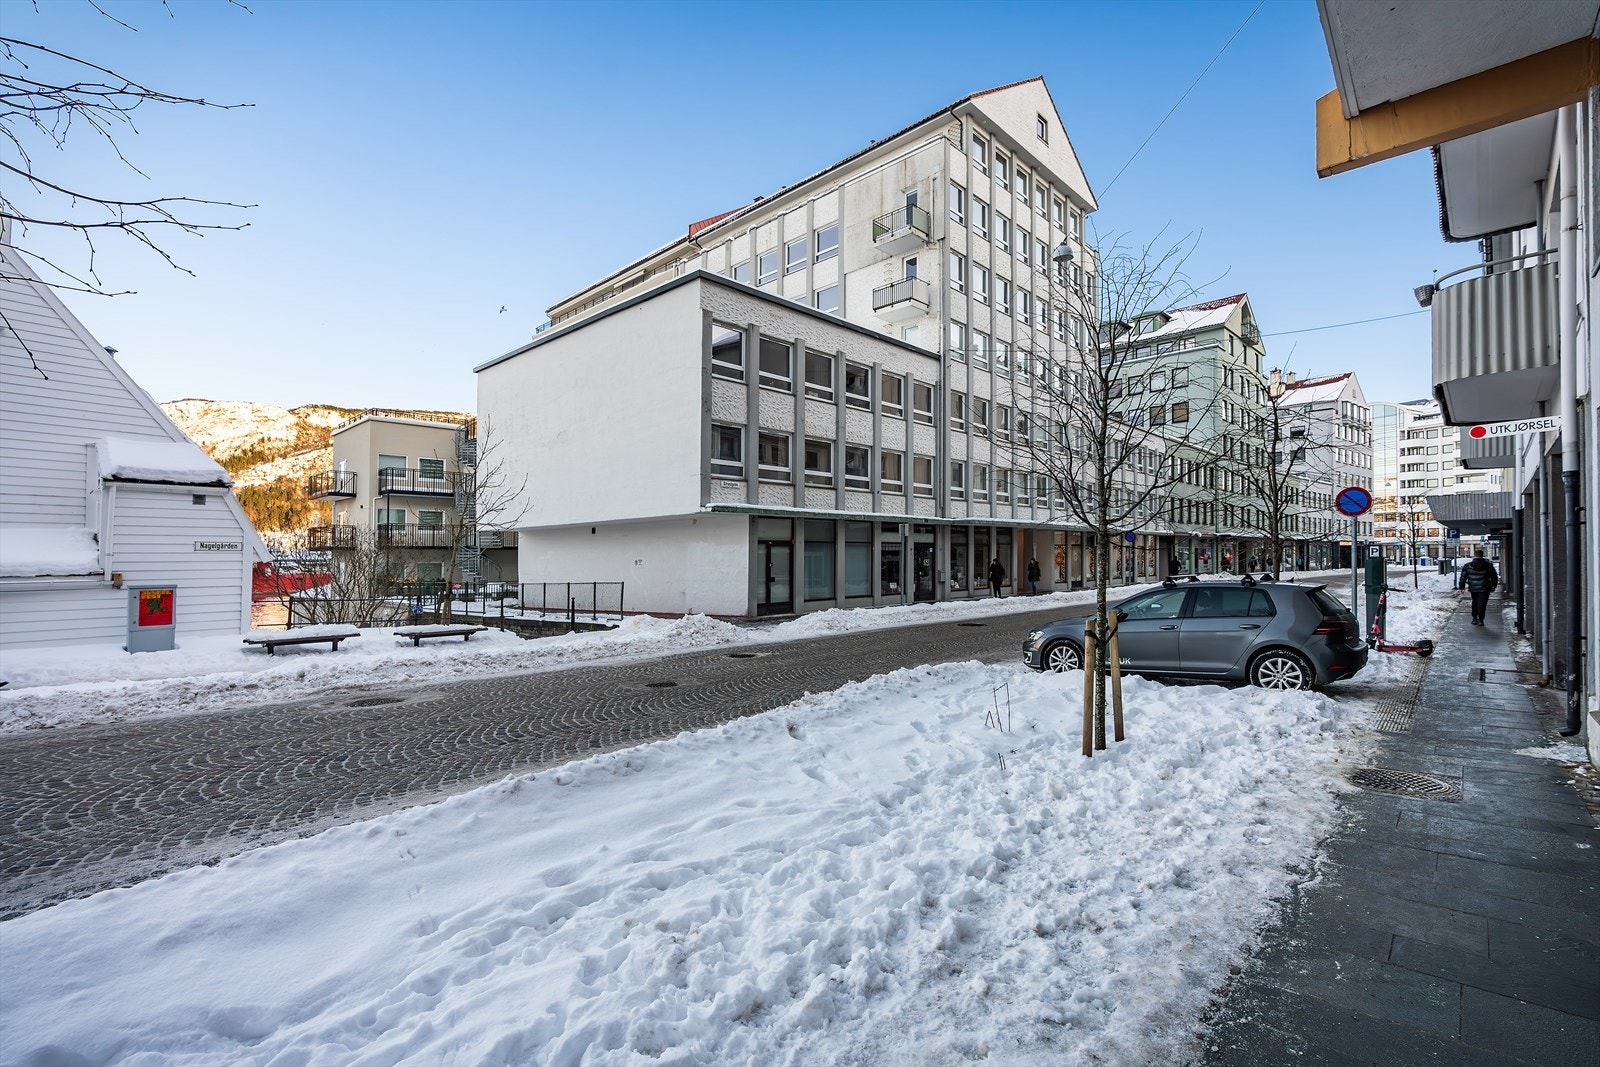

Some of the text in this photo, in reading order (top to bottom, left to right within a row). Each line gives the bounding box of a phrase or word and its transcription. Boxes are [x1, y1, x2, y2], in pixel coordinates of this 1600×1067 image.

[1490, 419, 1557, 435] UTKJØRSEL
[1450, 530, 1457, 538] P
[200, 542, 238, 551] Nagelgården
[1371, 547, 1379, 556] P
